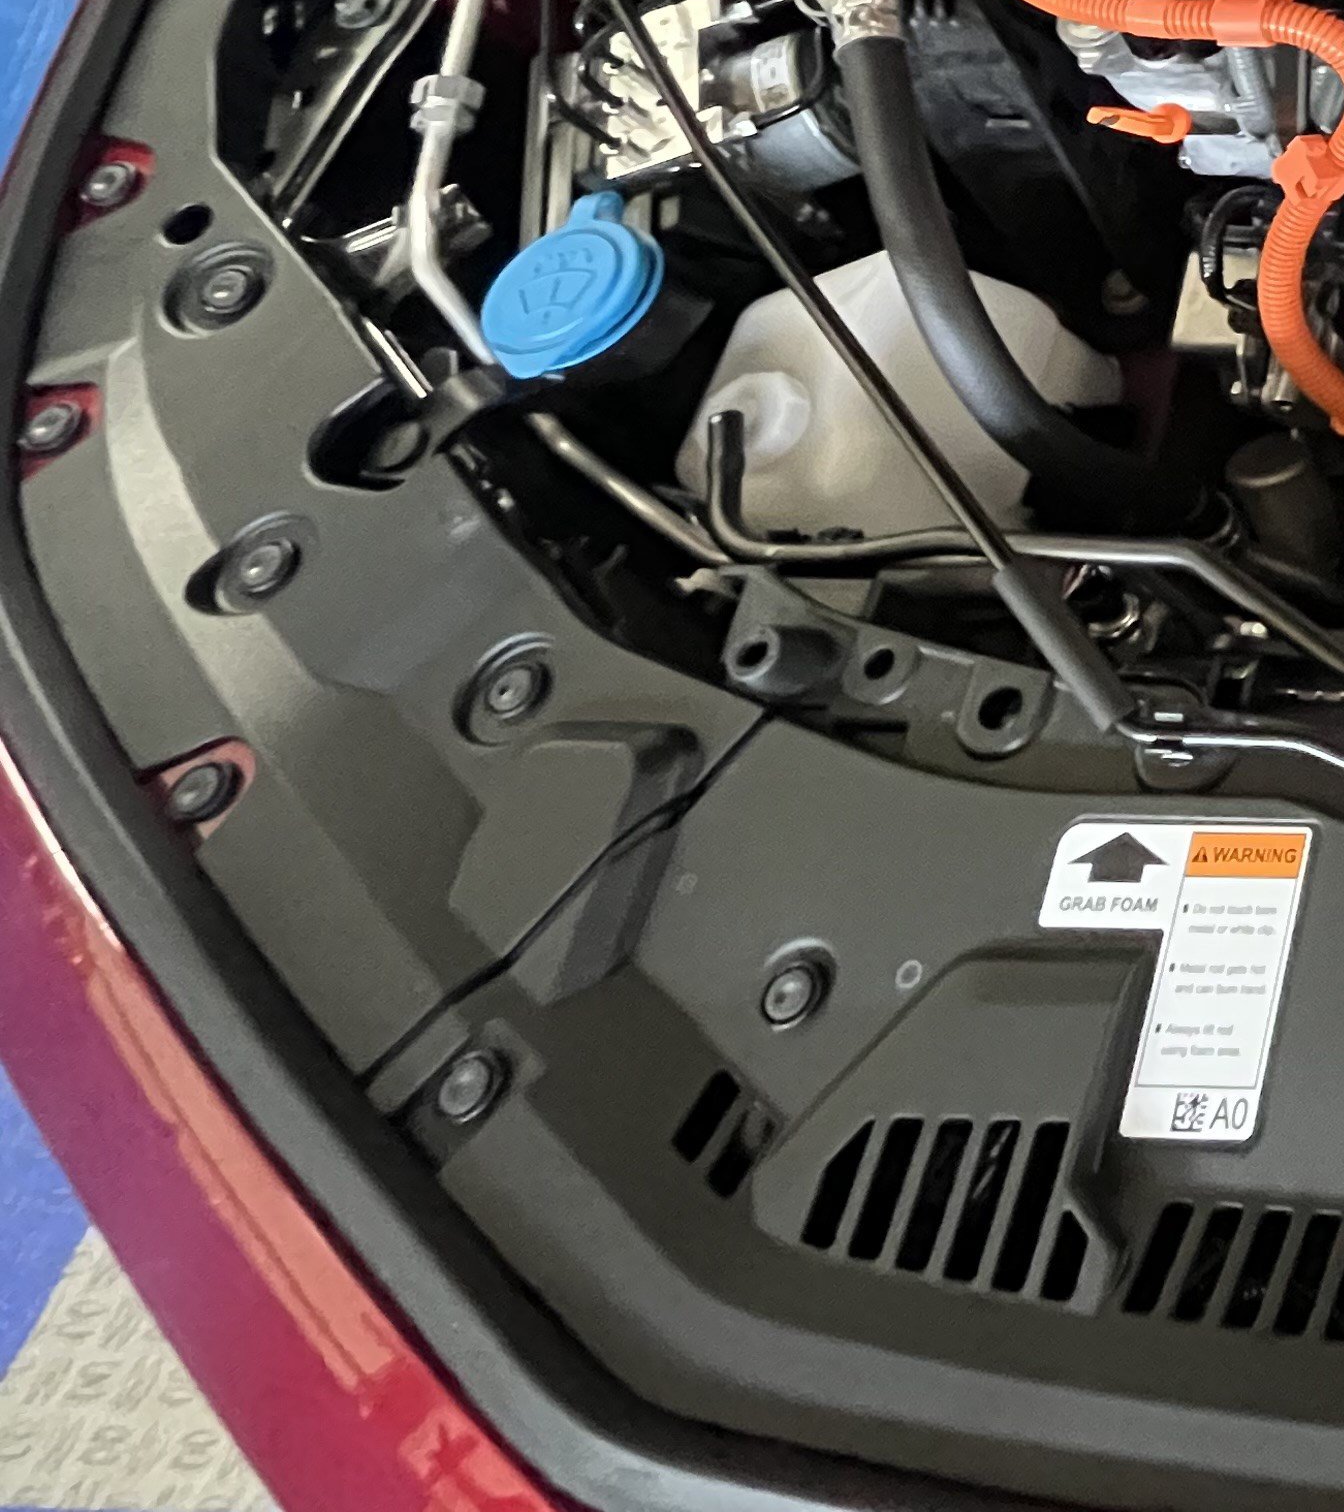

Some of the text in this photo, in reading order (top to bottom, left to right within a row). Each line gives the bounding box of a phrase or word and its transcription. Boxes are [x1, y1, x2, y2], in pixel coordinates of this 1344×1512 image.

[1213, 847, 1298, 864] WARNING
[1059, 896, 1159, 913] GRAB FOAM
